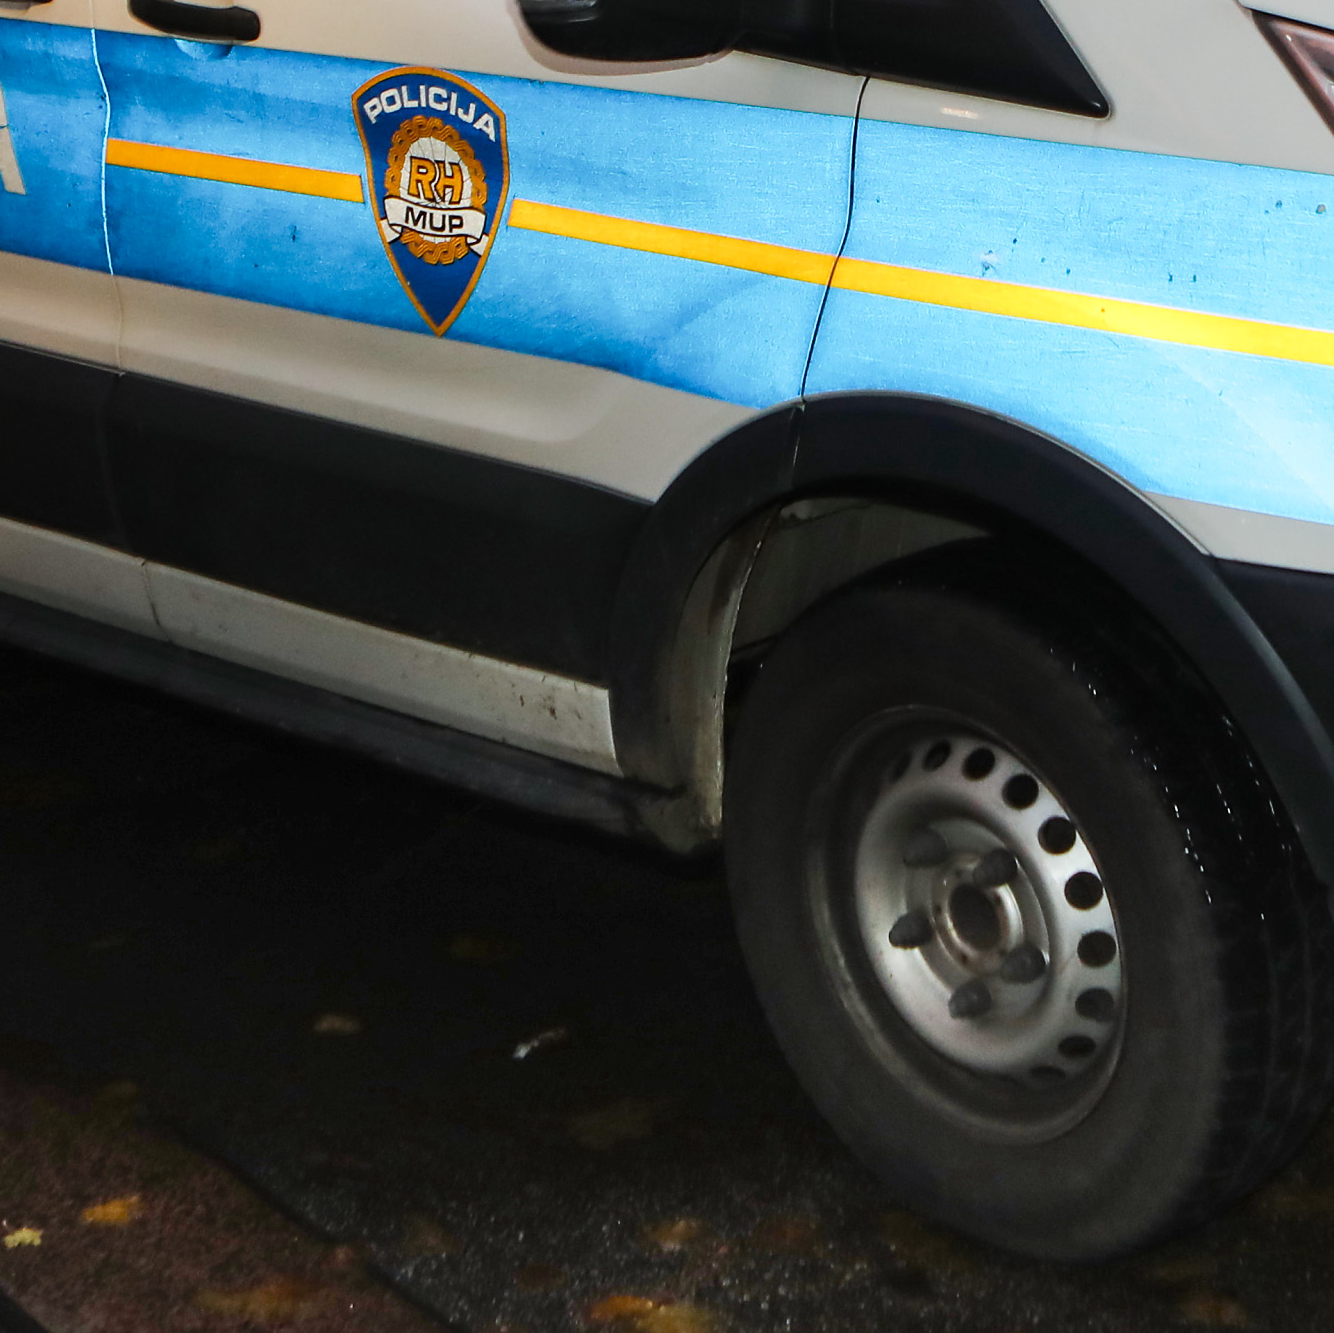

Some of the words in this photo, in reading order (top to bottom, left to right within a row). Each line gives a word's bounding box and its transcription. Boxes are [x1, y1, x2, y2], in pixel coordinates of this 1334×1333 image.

[364, 84, 496, 143] POLICIJA
[407, 156, 464, 205] RH
[404, 207, 465, 234] MUP
